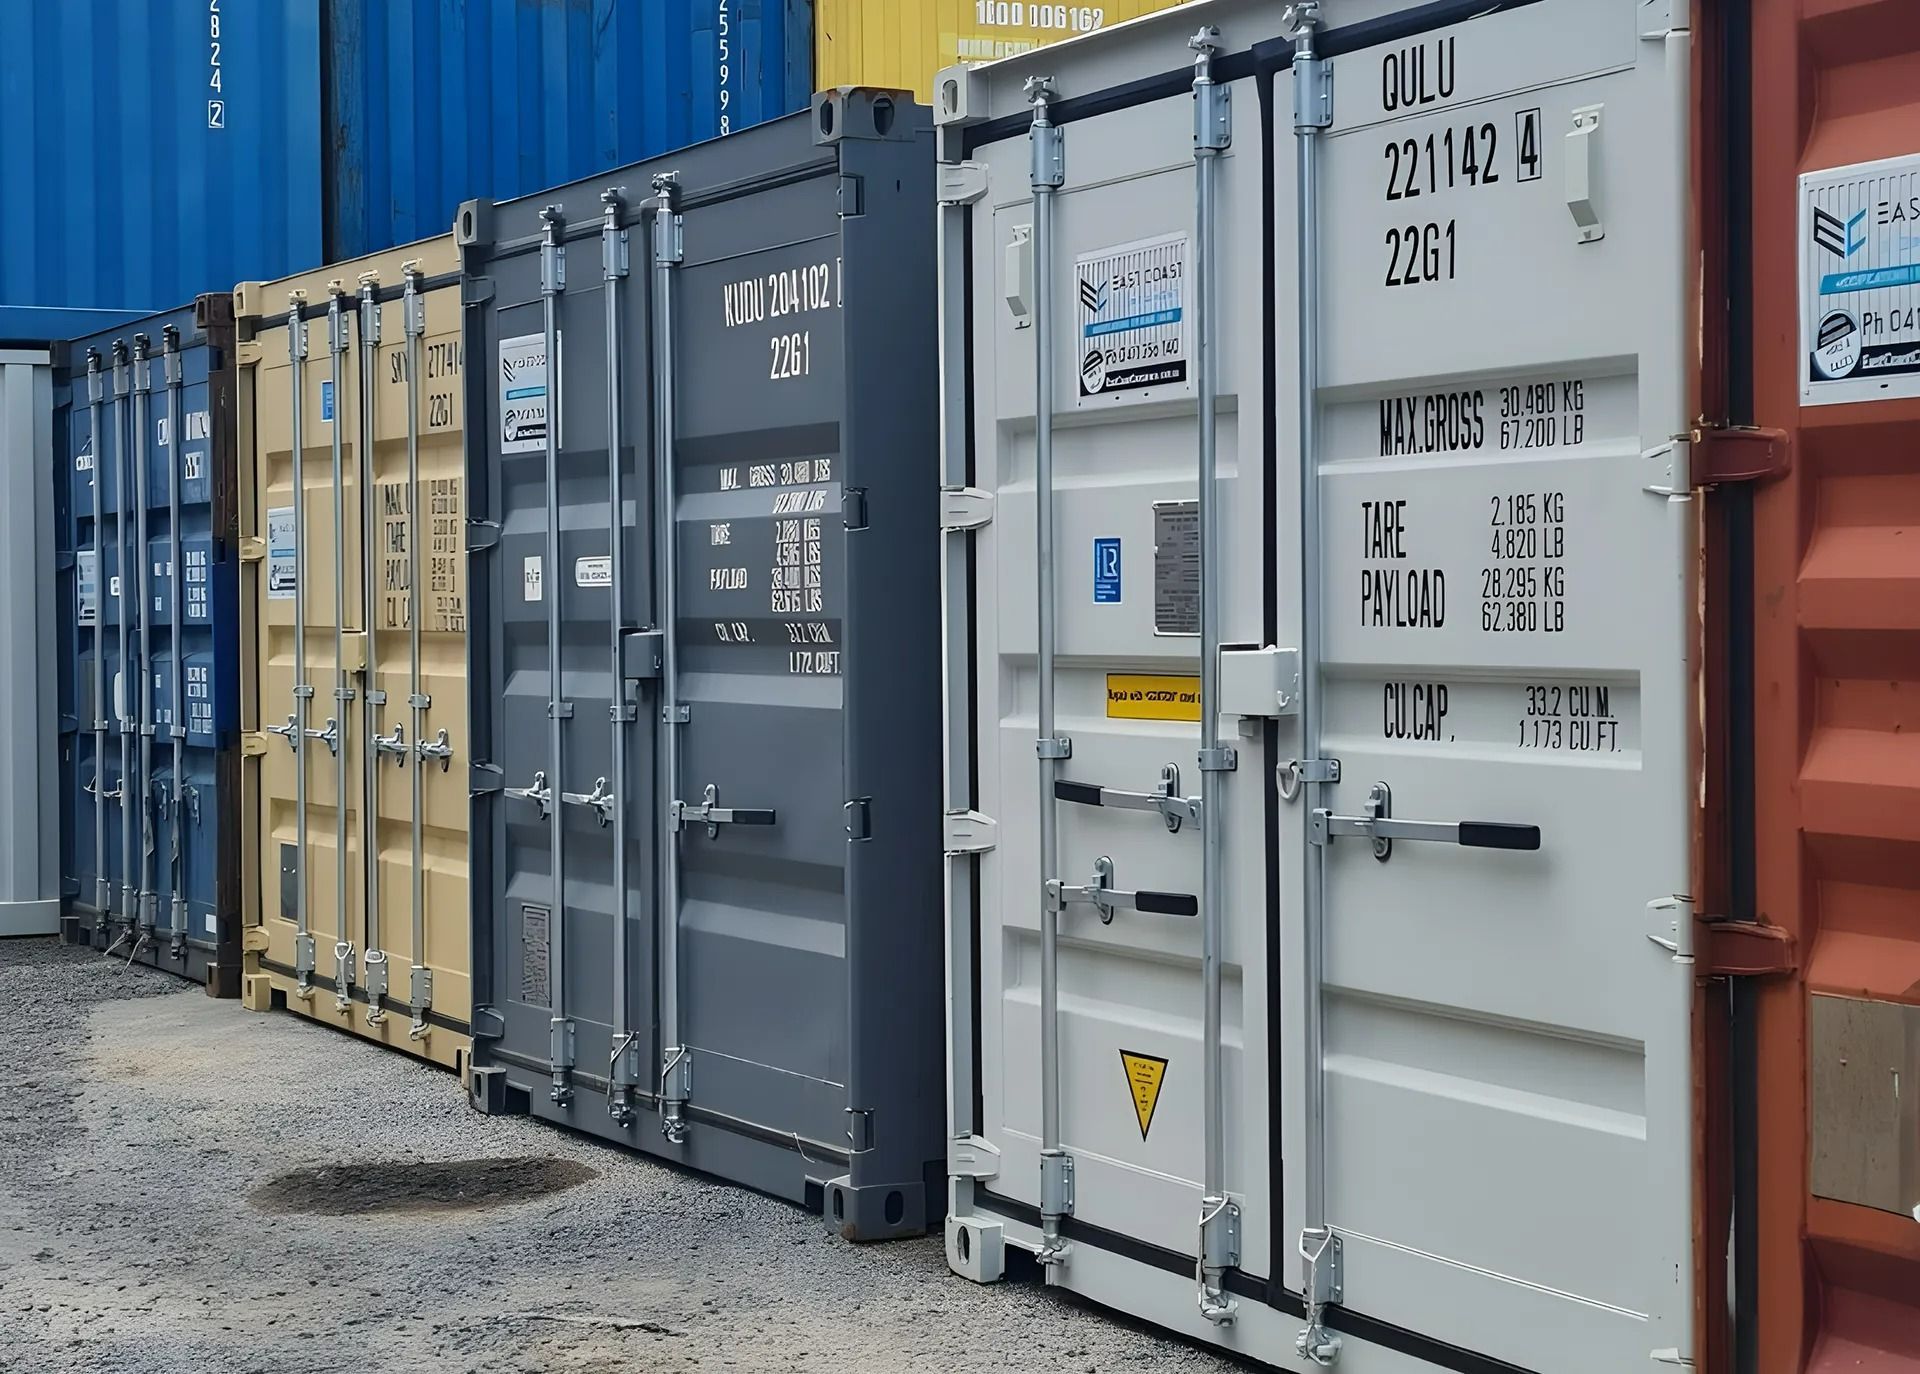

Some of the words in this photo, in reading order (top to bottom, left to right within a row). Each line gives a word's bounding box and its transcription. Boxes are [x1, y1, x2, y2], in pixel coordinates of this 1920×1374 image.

[1382, 36, 1455, 111] QULU
[1384, 122, 1499, 200] 221142
[1385, 219, 1456, 286] 22G1
[724, 277, 764, 327] KUDU
[768, 263, 830, 318] 204102
[1863, 311, 1883, 336] Ph
[770, 331, 809, 380] 22G1
[1562, 379, 1584, 413] KG
[1562, 414, 1584, 446] LB
[1361, 500, 1407, 559] TARE
[1543, 492, 1564, 524] KG
[1544, 526, 1564, 559] LB
[1361, 568, 1445, 628] PAYLOAD
[1543, 566, 1564, 598] KG
[1544, 600, 1564, 632] LB
